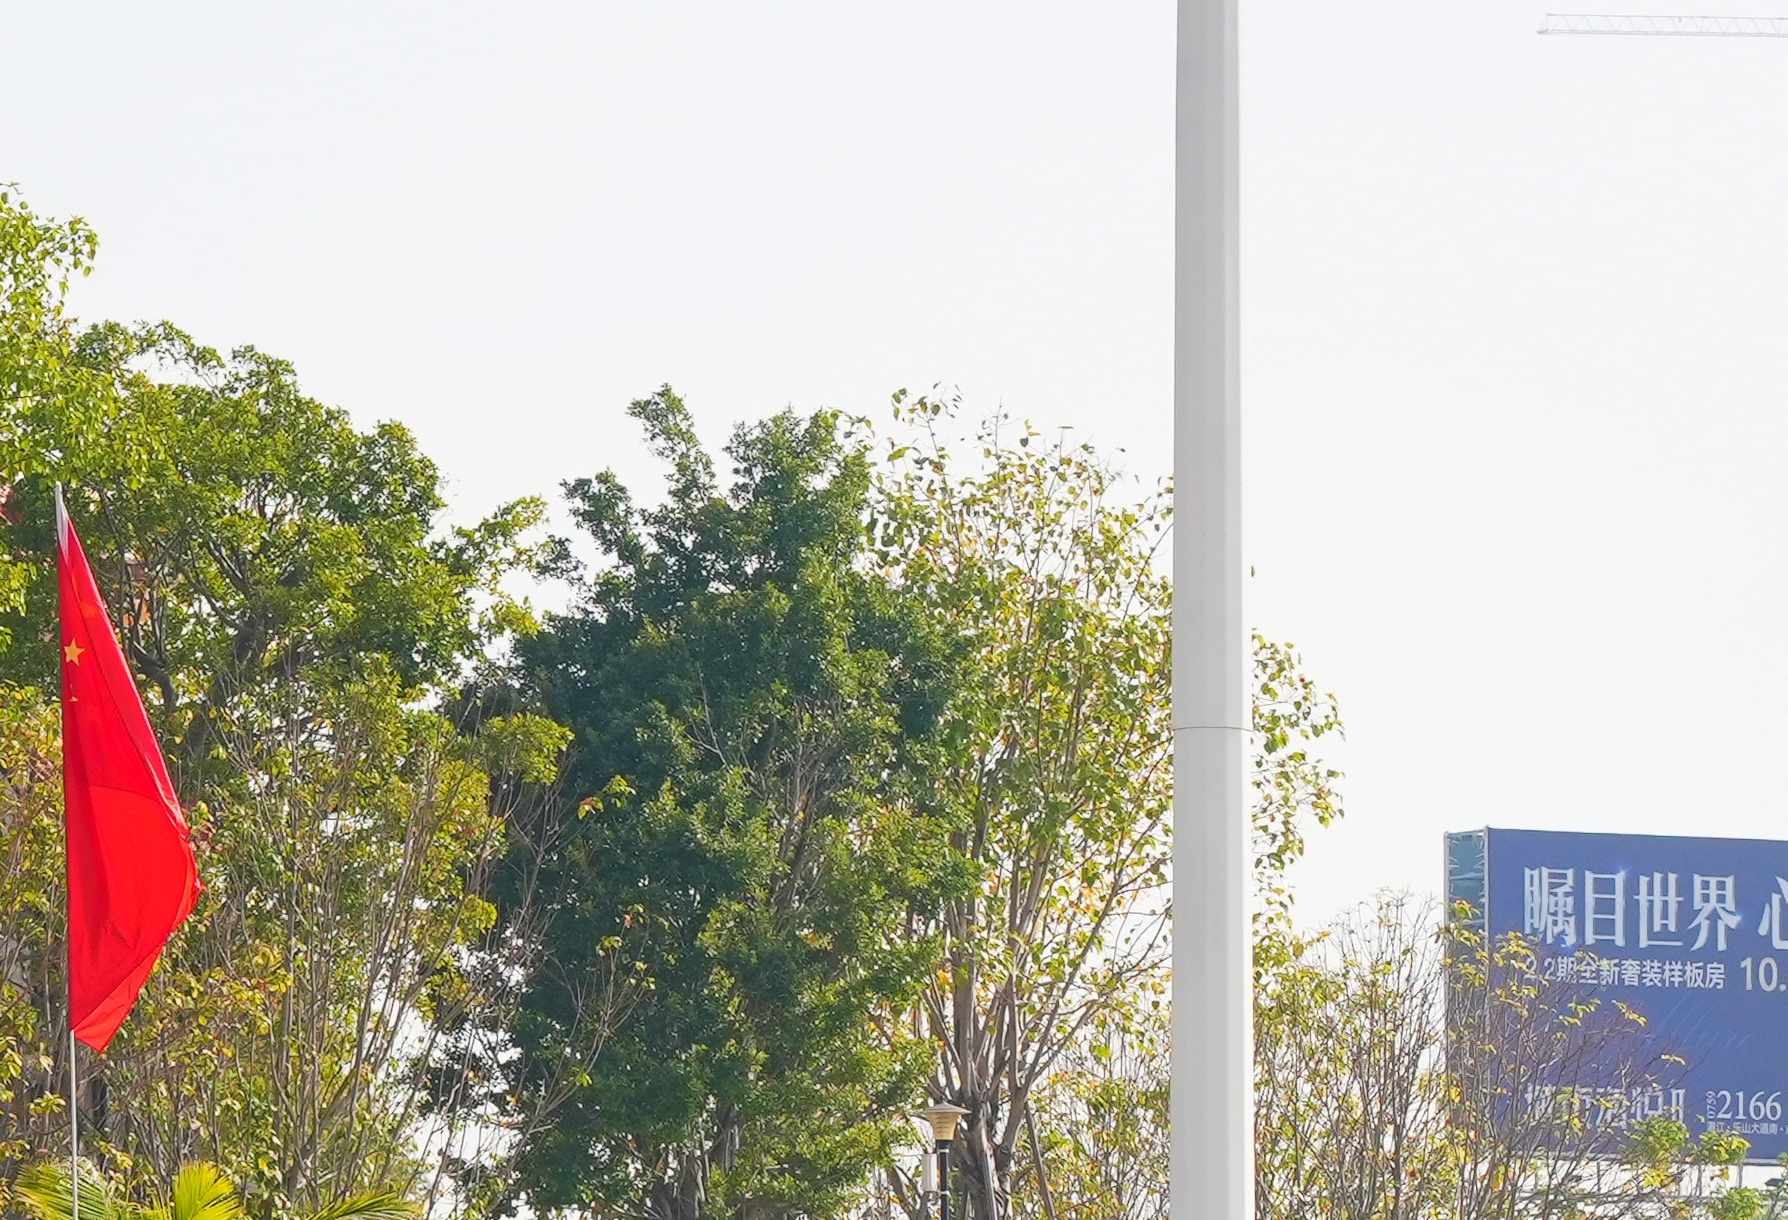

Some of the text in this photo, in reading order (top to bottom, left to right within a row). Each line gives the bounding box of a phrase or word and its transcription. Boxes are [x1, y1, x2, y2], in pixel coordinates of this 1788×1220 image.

[1523, 866, 1742, 952] 瞩目世界
[1716, 1089, 1783, 1121] 2166
